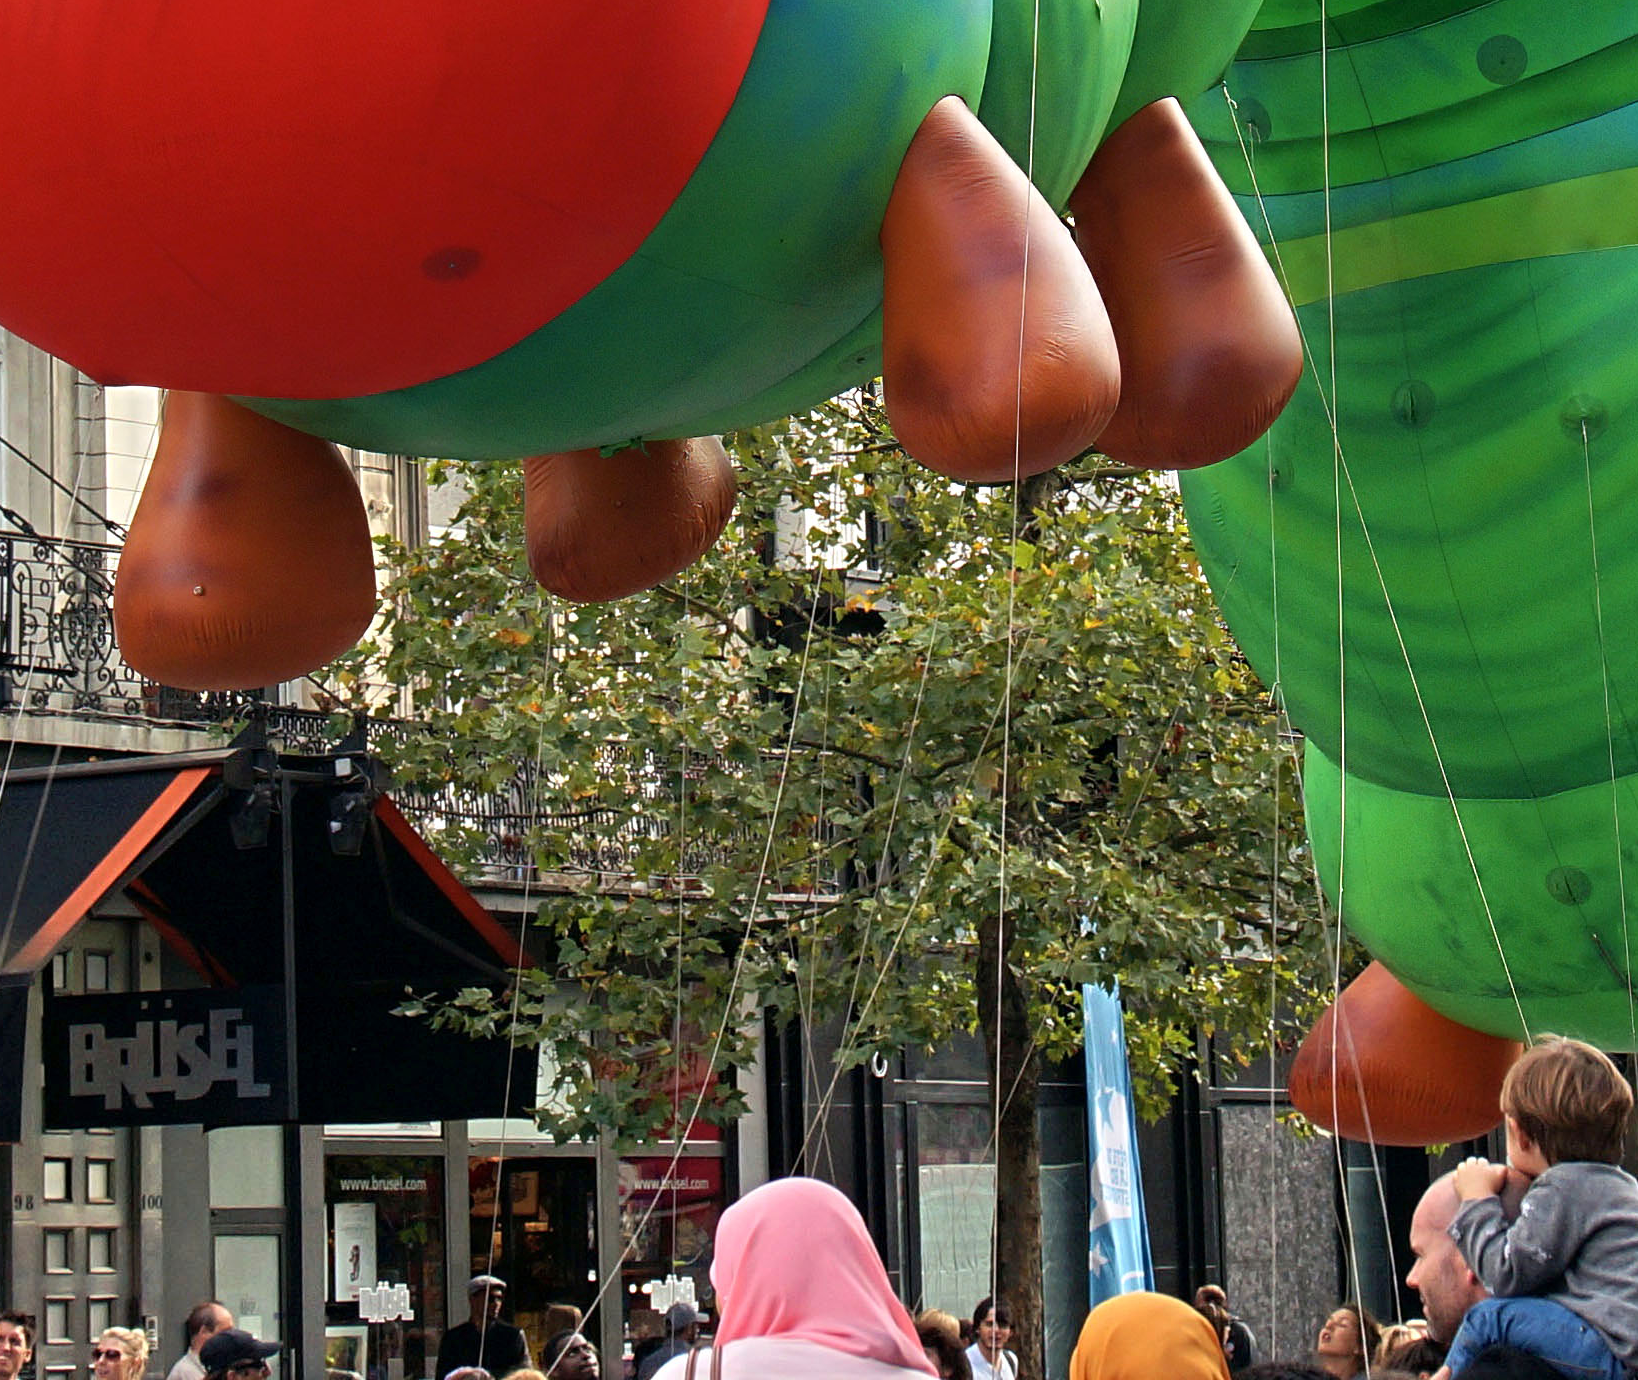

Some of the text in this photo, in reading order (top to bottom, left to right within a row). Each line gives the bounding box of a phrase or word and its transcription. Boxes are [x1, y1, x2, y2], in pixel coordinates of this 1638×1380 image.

[340, 1176, 428, 1191] www.brusel.com
[14, 1194, 34, 1210] 98
[141, 1193, 163, 1210] 100
